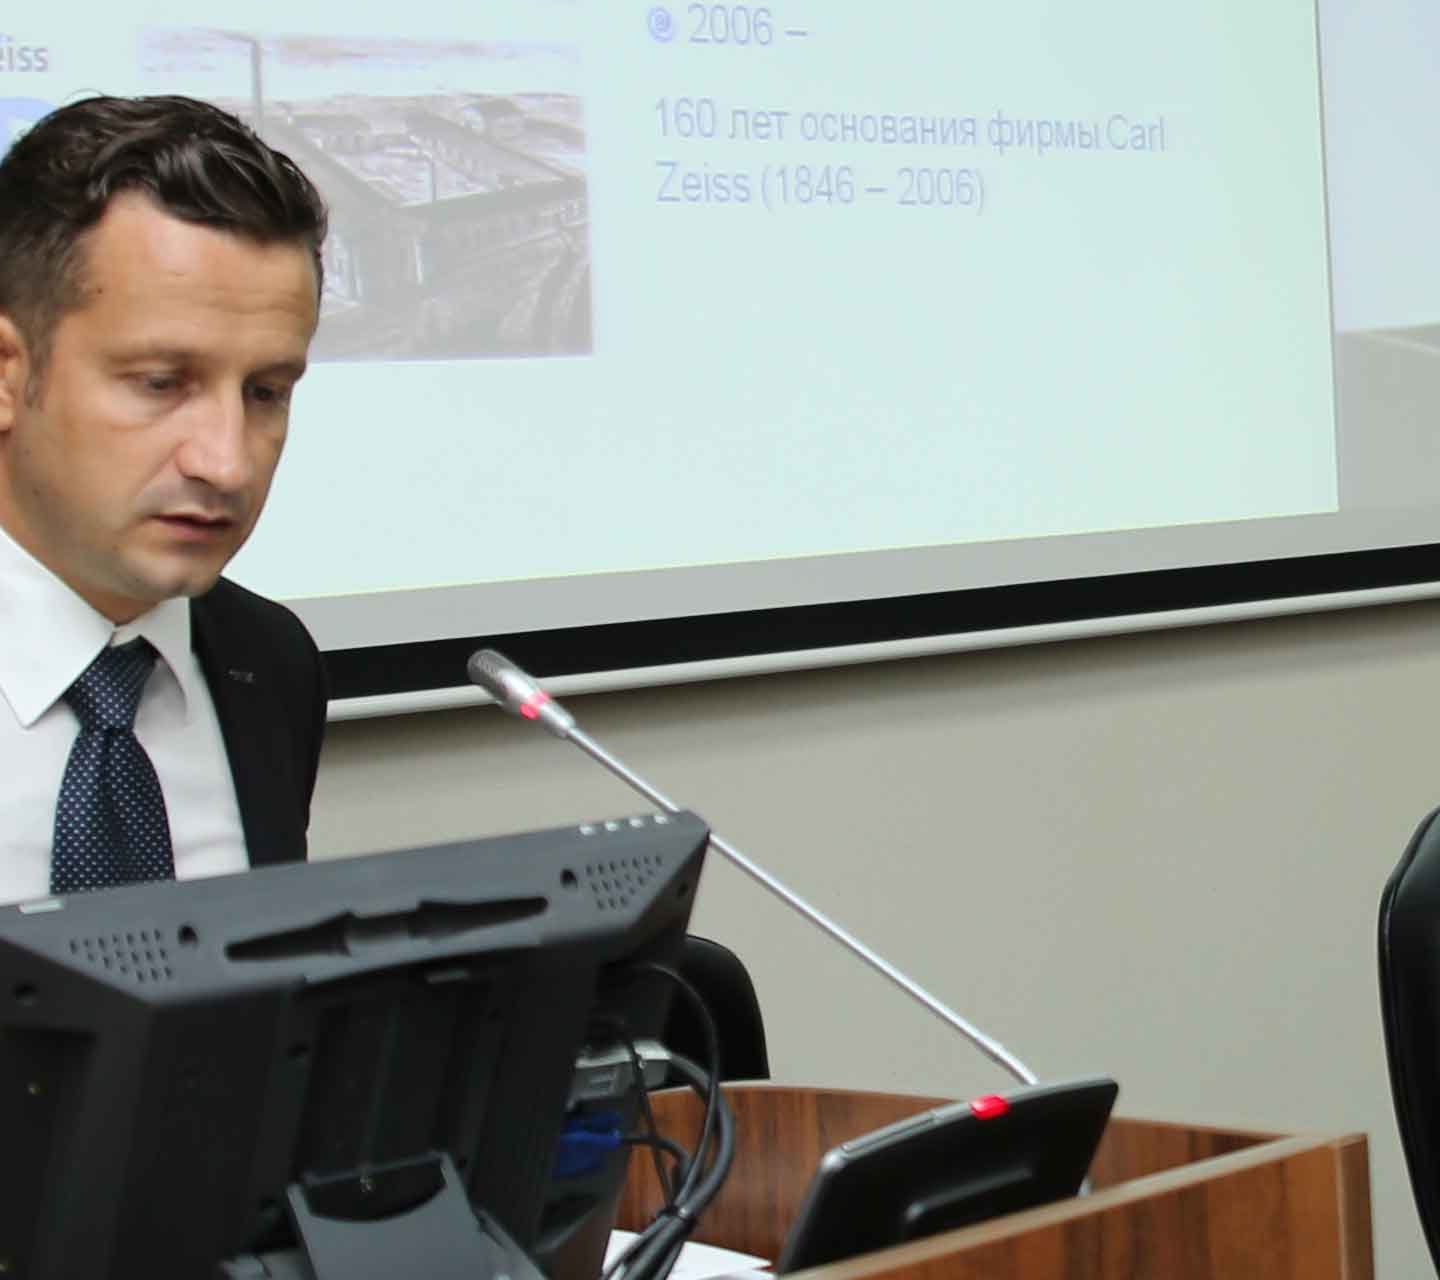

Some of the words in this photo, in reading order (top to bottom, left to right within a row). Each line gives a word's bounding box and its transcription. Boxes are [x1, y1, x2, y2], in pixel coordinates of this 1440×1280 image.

[687, 2, 774, 46] 2006
[655, 97, 718, 139] 160
[727, 107, 790, 142] лет
[799, 108, 978, 147] основания
[987, 109, 1101, 155] фирмы
[1106, 113, 1167, 153] Carl
[655, 160, 751, 204] Zeiss
[760, 163, 855, 215] (1846
[897, 166, 986, 216] 2006)
